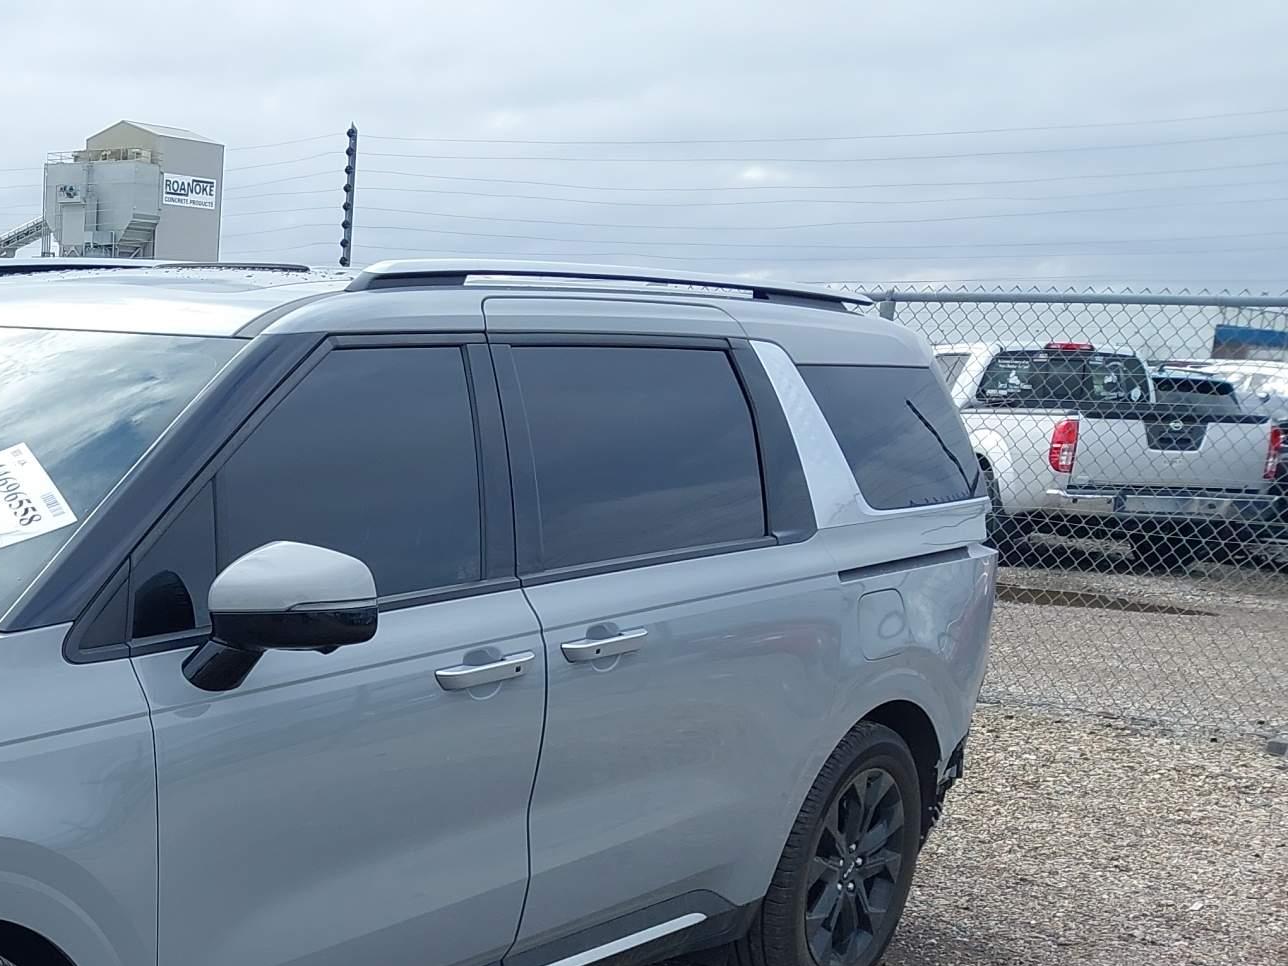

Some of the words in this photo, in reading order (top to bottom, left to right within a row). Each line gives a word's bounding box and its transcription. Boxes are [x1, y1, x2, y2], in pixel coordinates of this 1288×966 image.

[165, 179, 214, 197] ROANOKE
[165, 196, 189, 205] CONCRETE
[189, 200, 214, 208] PRODUCTS
